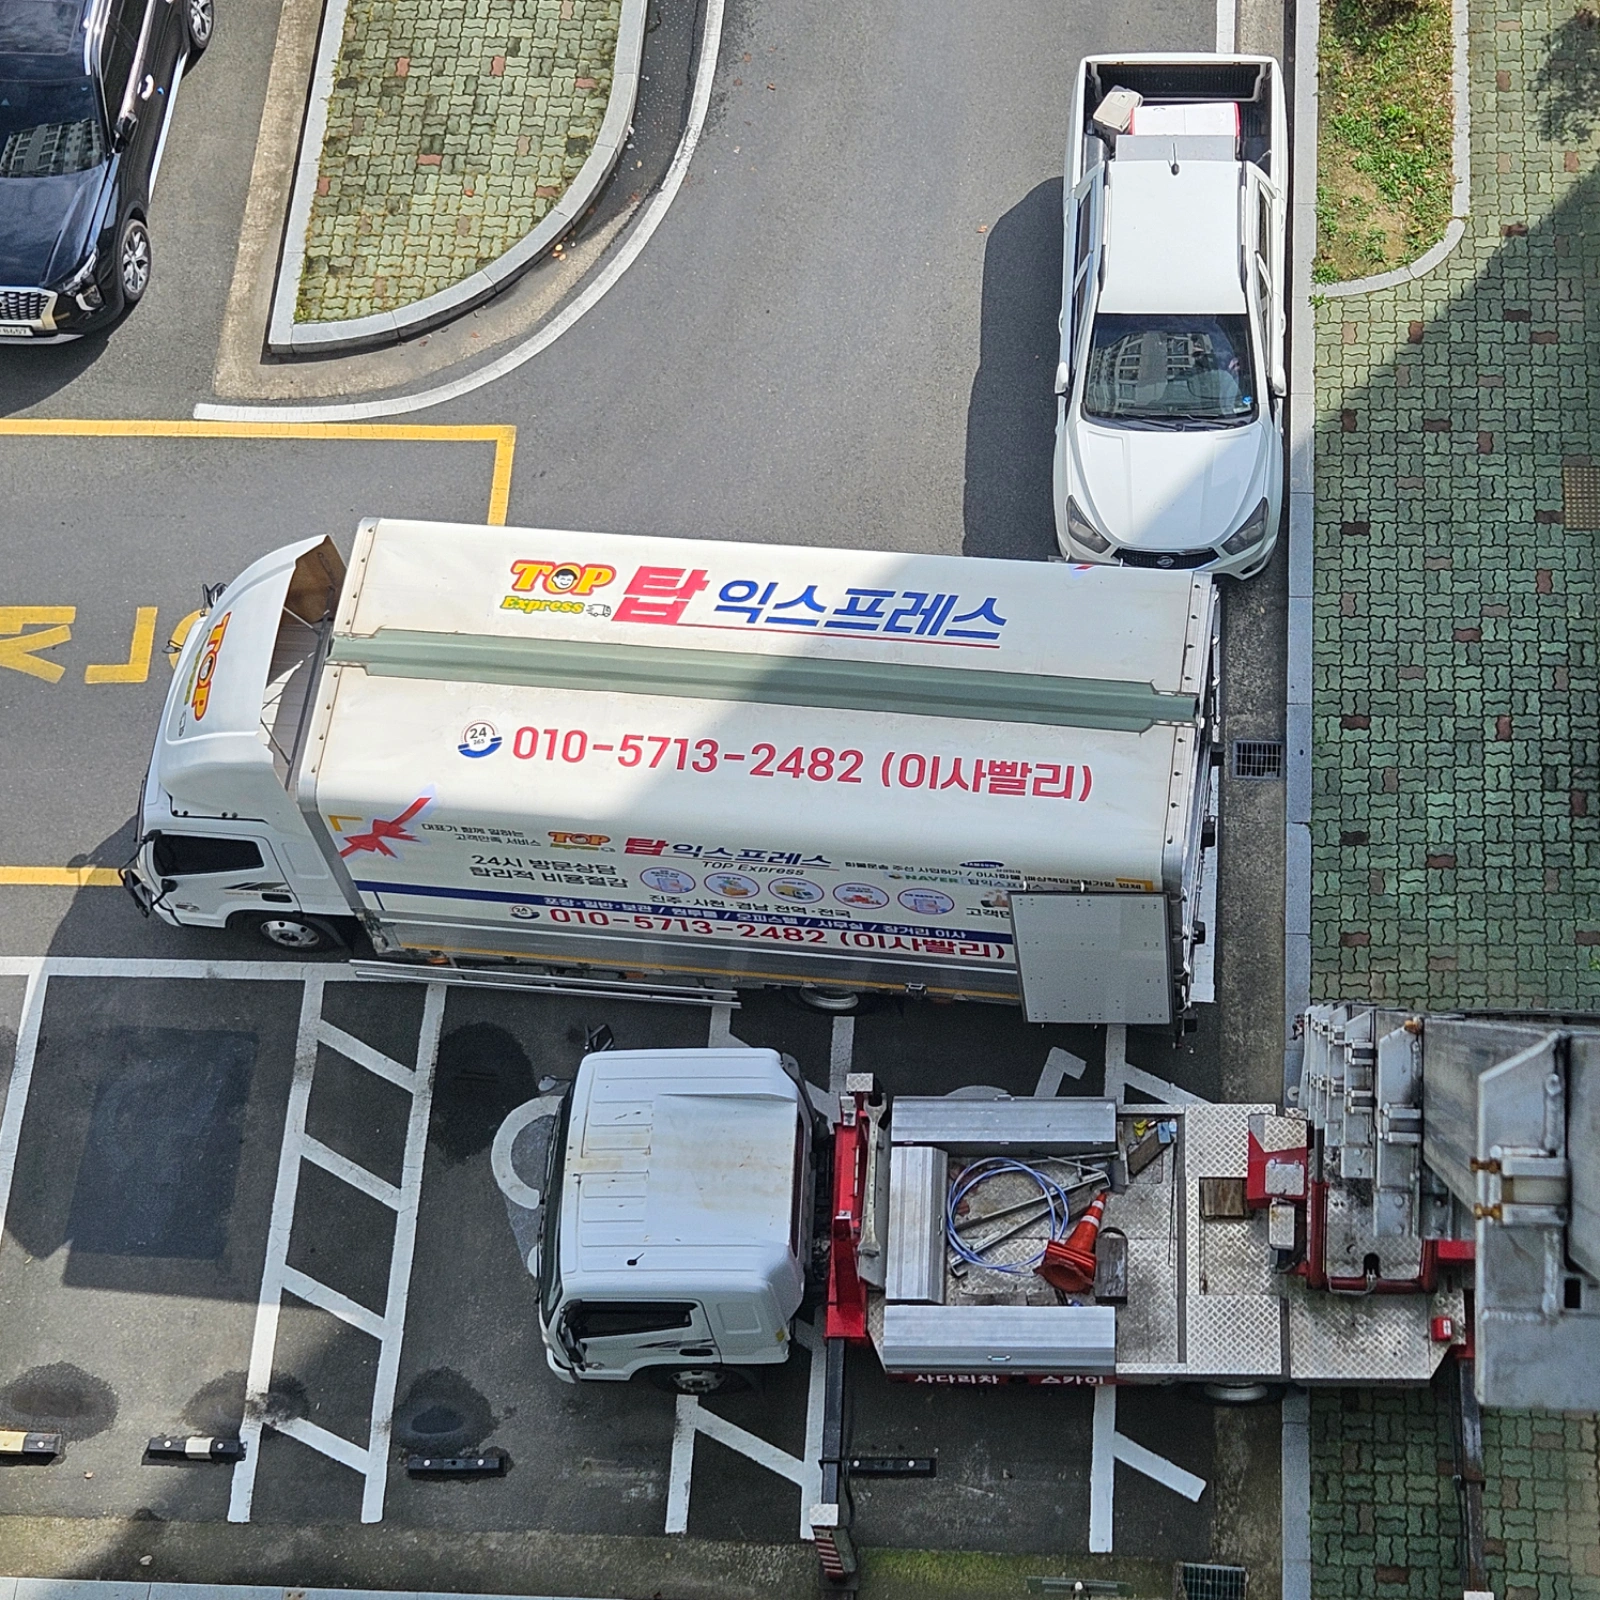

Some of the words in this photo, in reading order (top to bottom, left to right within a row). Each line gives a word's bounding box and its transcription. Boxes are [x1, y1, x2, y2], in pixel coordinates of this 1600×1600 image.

[510, 560, 616, 596] TOP
[500, 596, 585, 614] Express
[611, 566, 709, 624] 탑
[714, 580, 1007, 640] 익스프레스
[191, 611, 232, 721] TOP
[469, 726, 487, 739] 24
[512, 726, 865, 783] 010-5713-2482
[881, 751, 1093, 801] (이사빨리)
[421, 823, 457, 832] 대표가
[506, 837, 541, 847] 서비스
[548, 831, 611, 846] TOP
[624, 837, 669, 856] 탑
[672, 844, 832, 868] 익스프레스
[471, 854, 523, 868] 24시
[529, 858, 617, 875] 방문상담
[702, 861, 734, 870] TOP
[737, 864, 804, 876] Express
[469, 866, 535, 881] 합리적
[541, 872, 629, 888] 비용절감
[904, 874, 959, 883] NAVER
[550, 908, 828, 944] 010-5713-2482
[840, 932, 1005, 959] (이사빨리)
[736, 912, 798, 925] 오피스텔
[817, 920, 864, 931] 사무실
[935, 929, 967, 939] 이사
[914, 1374, 999, 1385] 사다리차
[1040, 1375, 1104, 1386] 스카이
